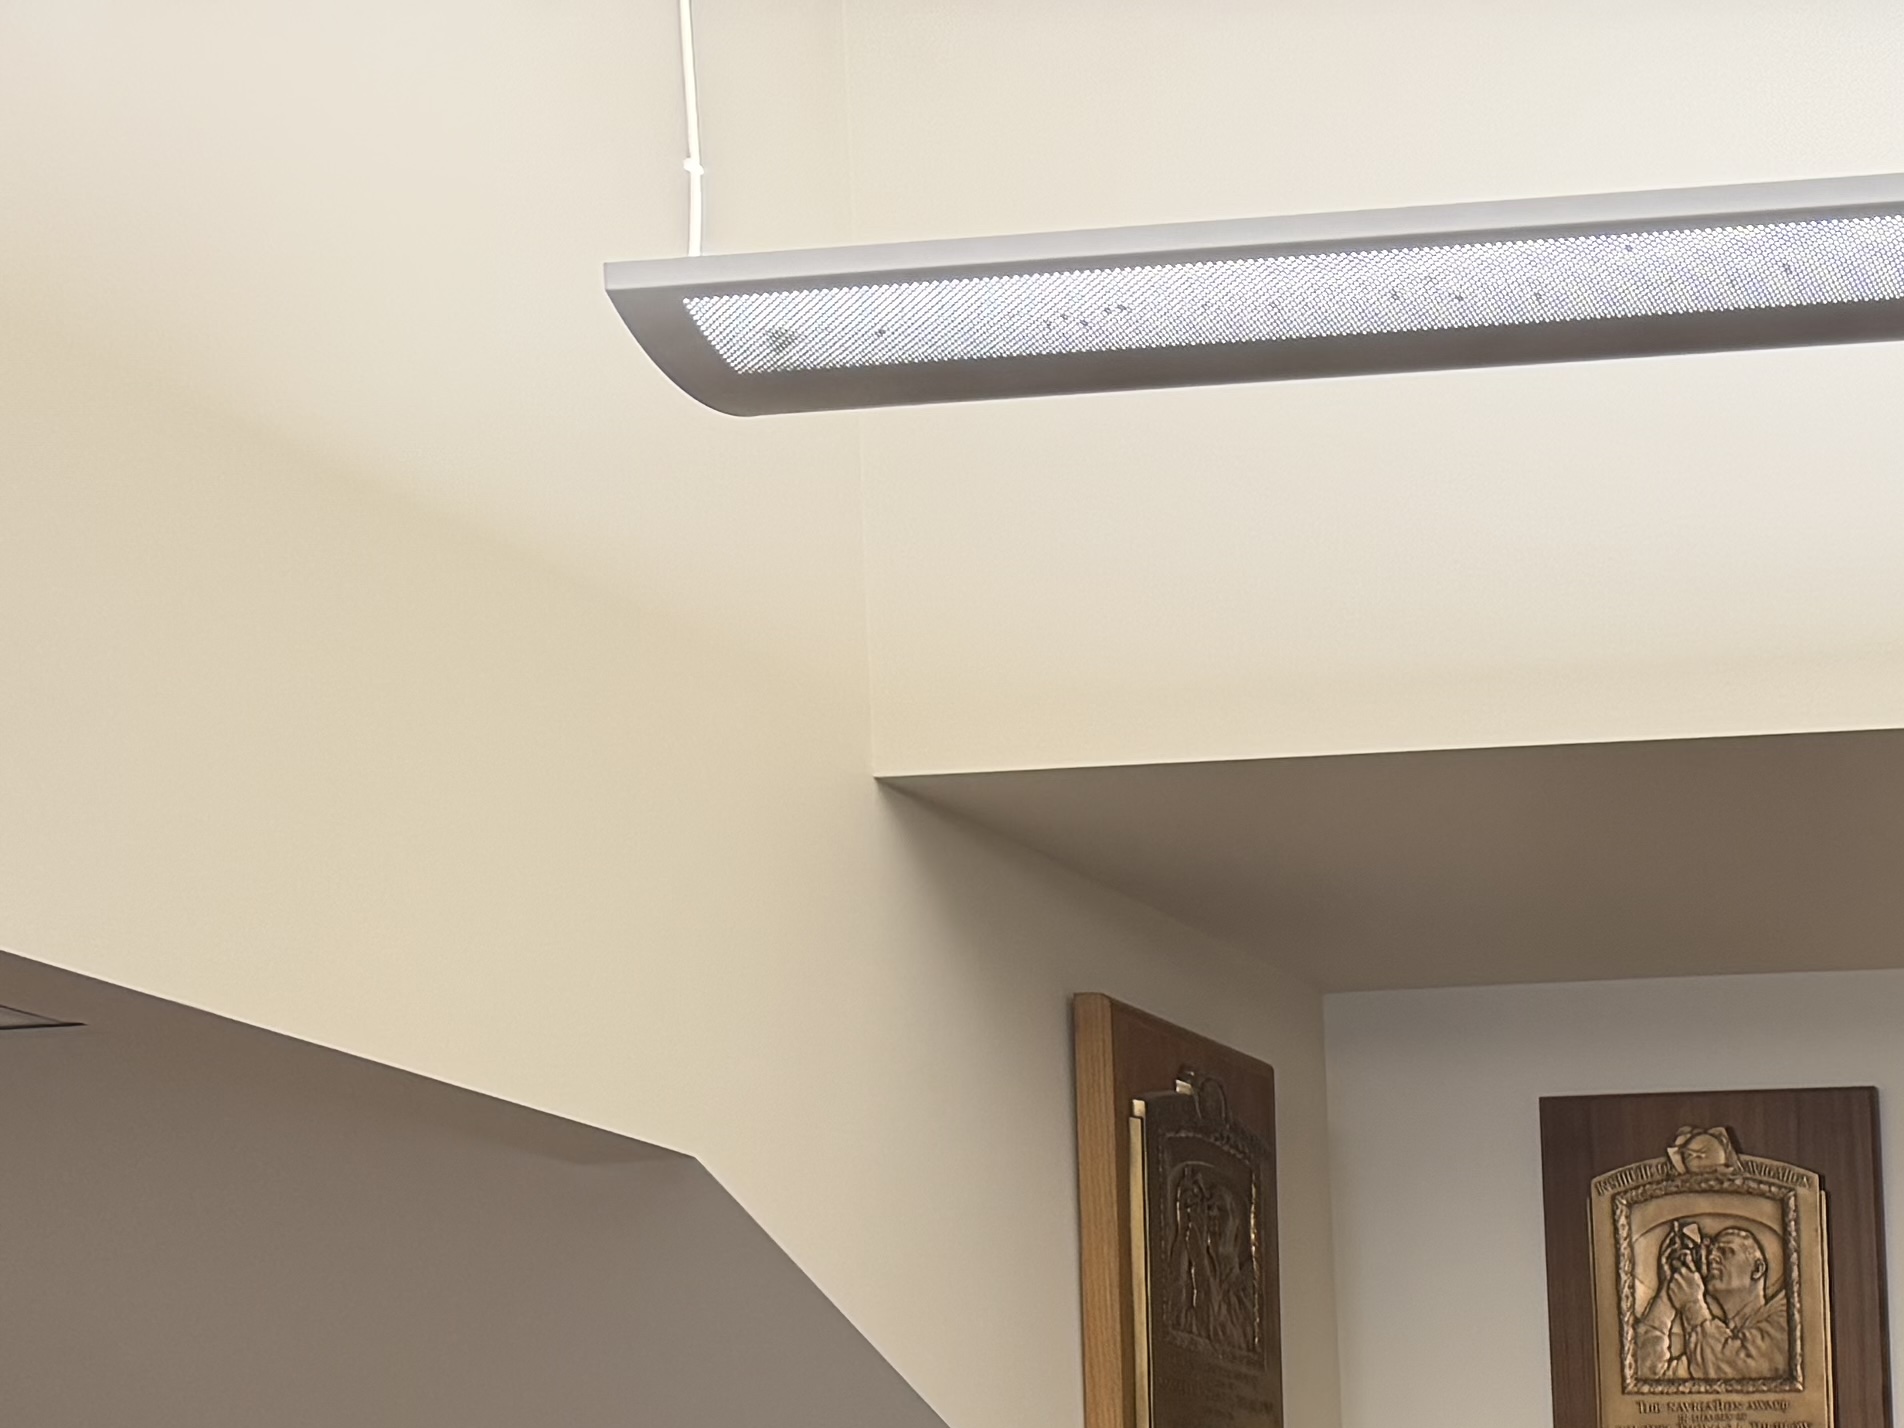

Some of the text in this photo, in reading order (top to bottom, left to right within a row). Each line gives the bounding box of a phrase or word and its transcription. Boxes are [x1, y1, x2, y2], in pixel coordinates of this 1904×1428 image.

[1635, 1399, 1791, 1415] THE NAVIGATION AWARD
